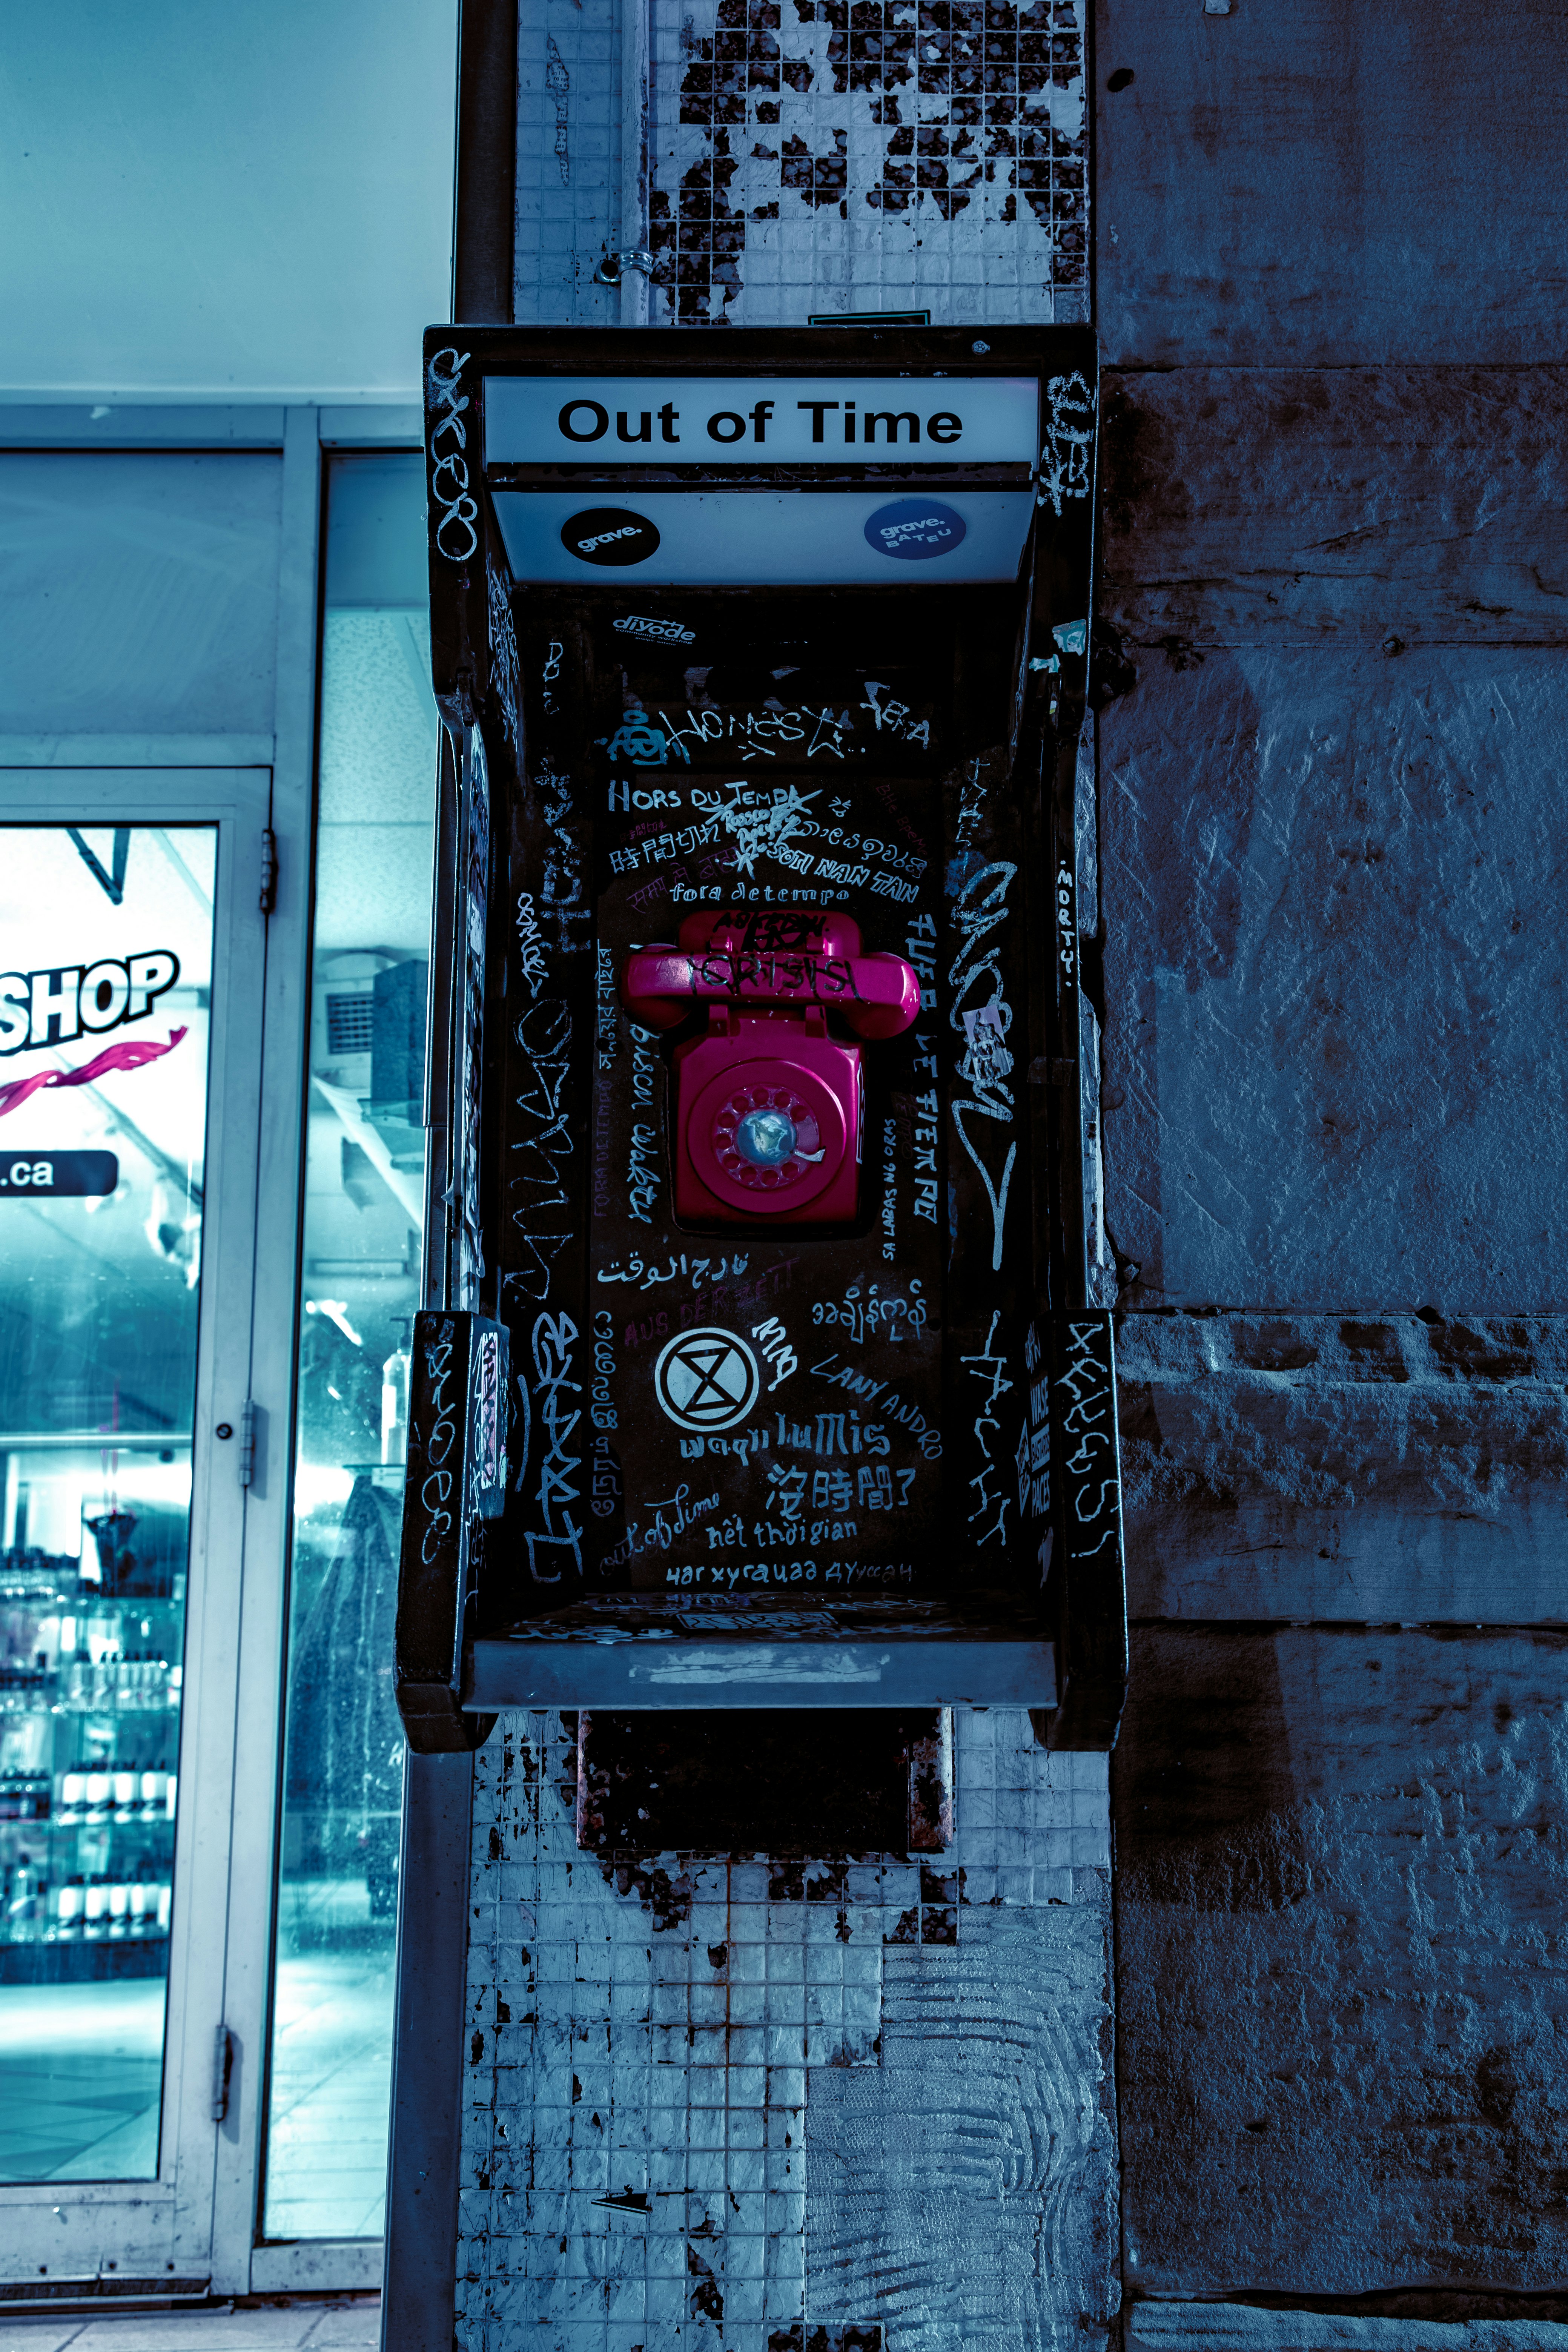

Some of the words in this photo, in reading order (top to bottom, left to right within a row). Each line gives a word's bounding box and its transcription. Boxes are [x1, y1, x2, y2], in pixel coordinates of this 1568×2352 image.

[558, 399, 680, 443] Out
[707, 400, 774, 443] of
[797, 400, 963, 444] Time
[578, 526, 642, 553] grave.
[880, 517, 945, 540] grave.
[613, 616, 696, 640] diyode
[616, 628, 656, 638] community
[658, 636, 693, 645] workshop
[608, 779, 681, 812] HORS
[691, 788, 721, 809] DU
[609, 824, 720, 874] 時間切れ
[670, 882, 722, 902] fora
[883, 1118, 897, 1156] ORAS
[913, 1088, 939, 1224] TIEMPO
[883, 1162, 897, 1183] NG
[882, 1188, 898, 1237] LABAS
[883, 1242, 896, 1261] SA
[597, 1251, 686, 1290] الوقت
